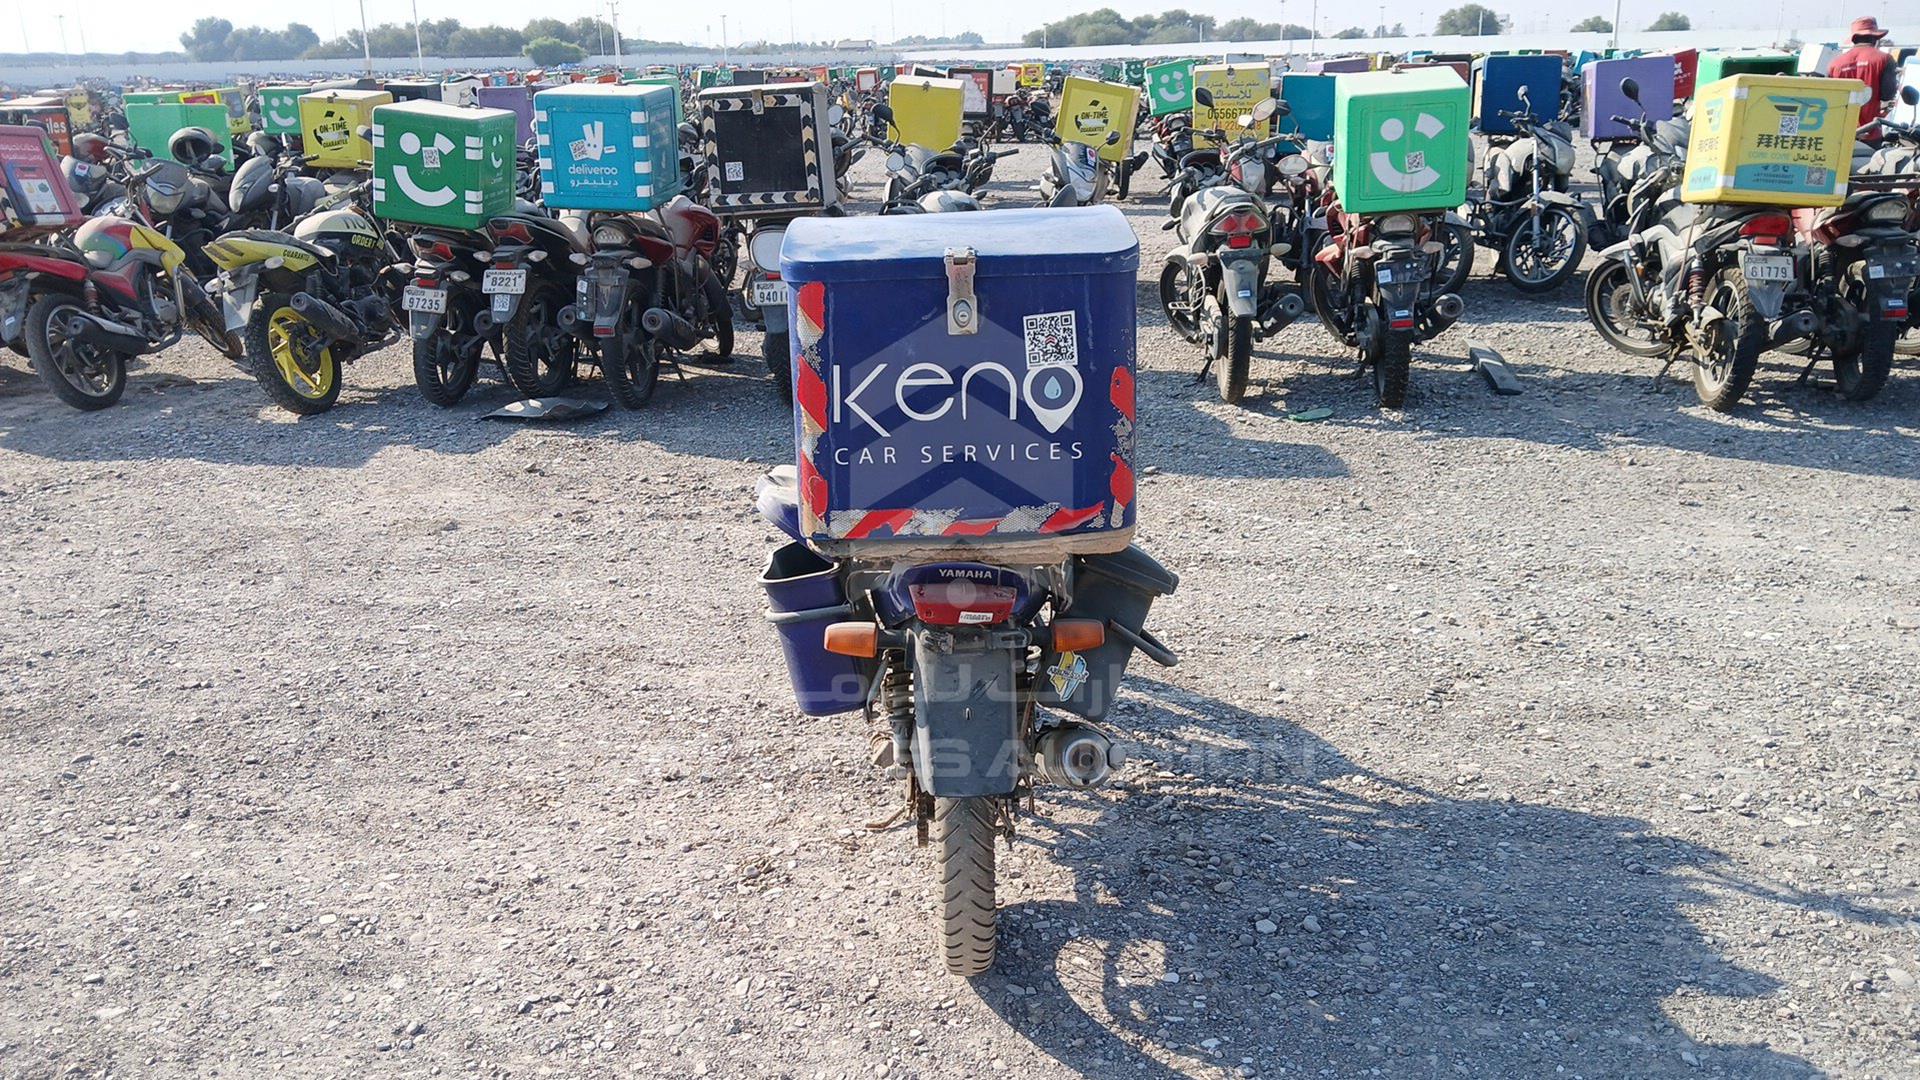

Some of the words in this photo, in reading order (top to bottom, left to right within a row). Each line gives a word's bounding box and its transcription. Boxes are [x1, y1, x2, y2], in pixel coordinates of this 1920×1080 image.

[45, 117, 67, 134] iles
[319, 121, 348, 133] ON-TIME
[568, 164, 618, 175] deliveroo
[1751, 266, 1787, 278] 61779
[490, 276, 517, 287] 8221
[408, 297, 440, 311] 97235
[834, 447, 897, 466] CAR
[920, 442, 1084, 464] SERVICES
[939, 569, 993, 579] YAMAHA
